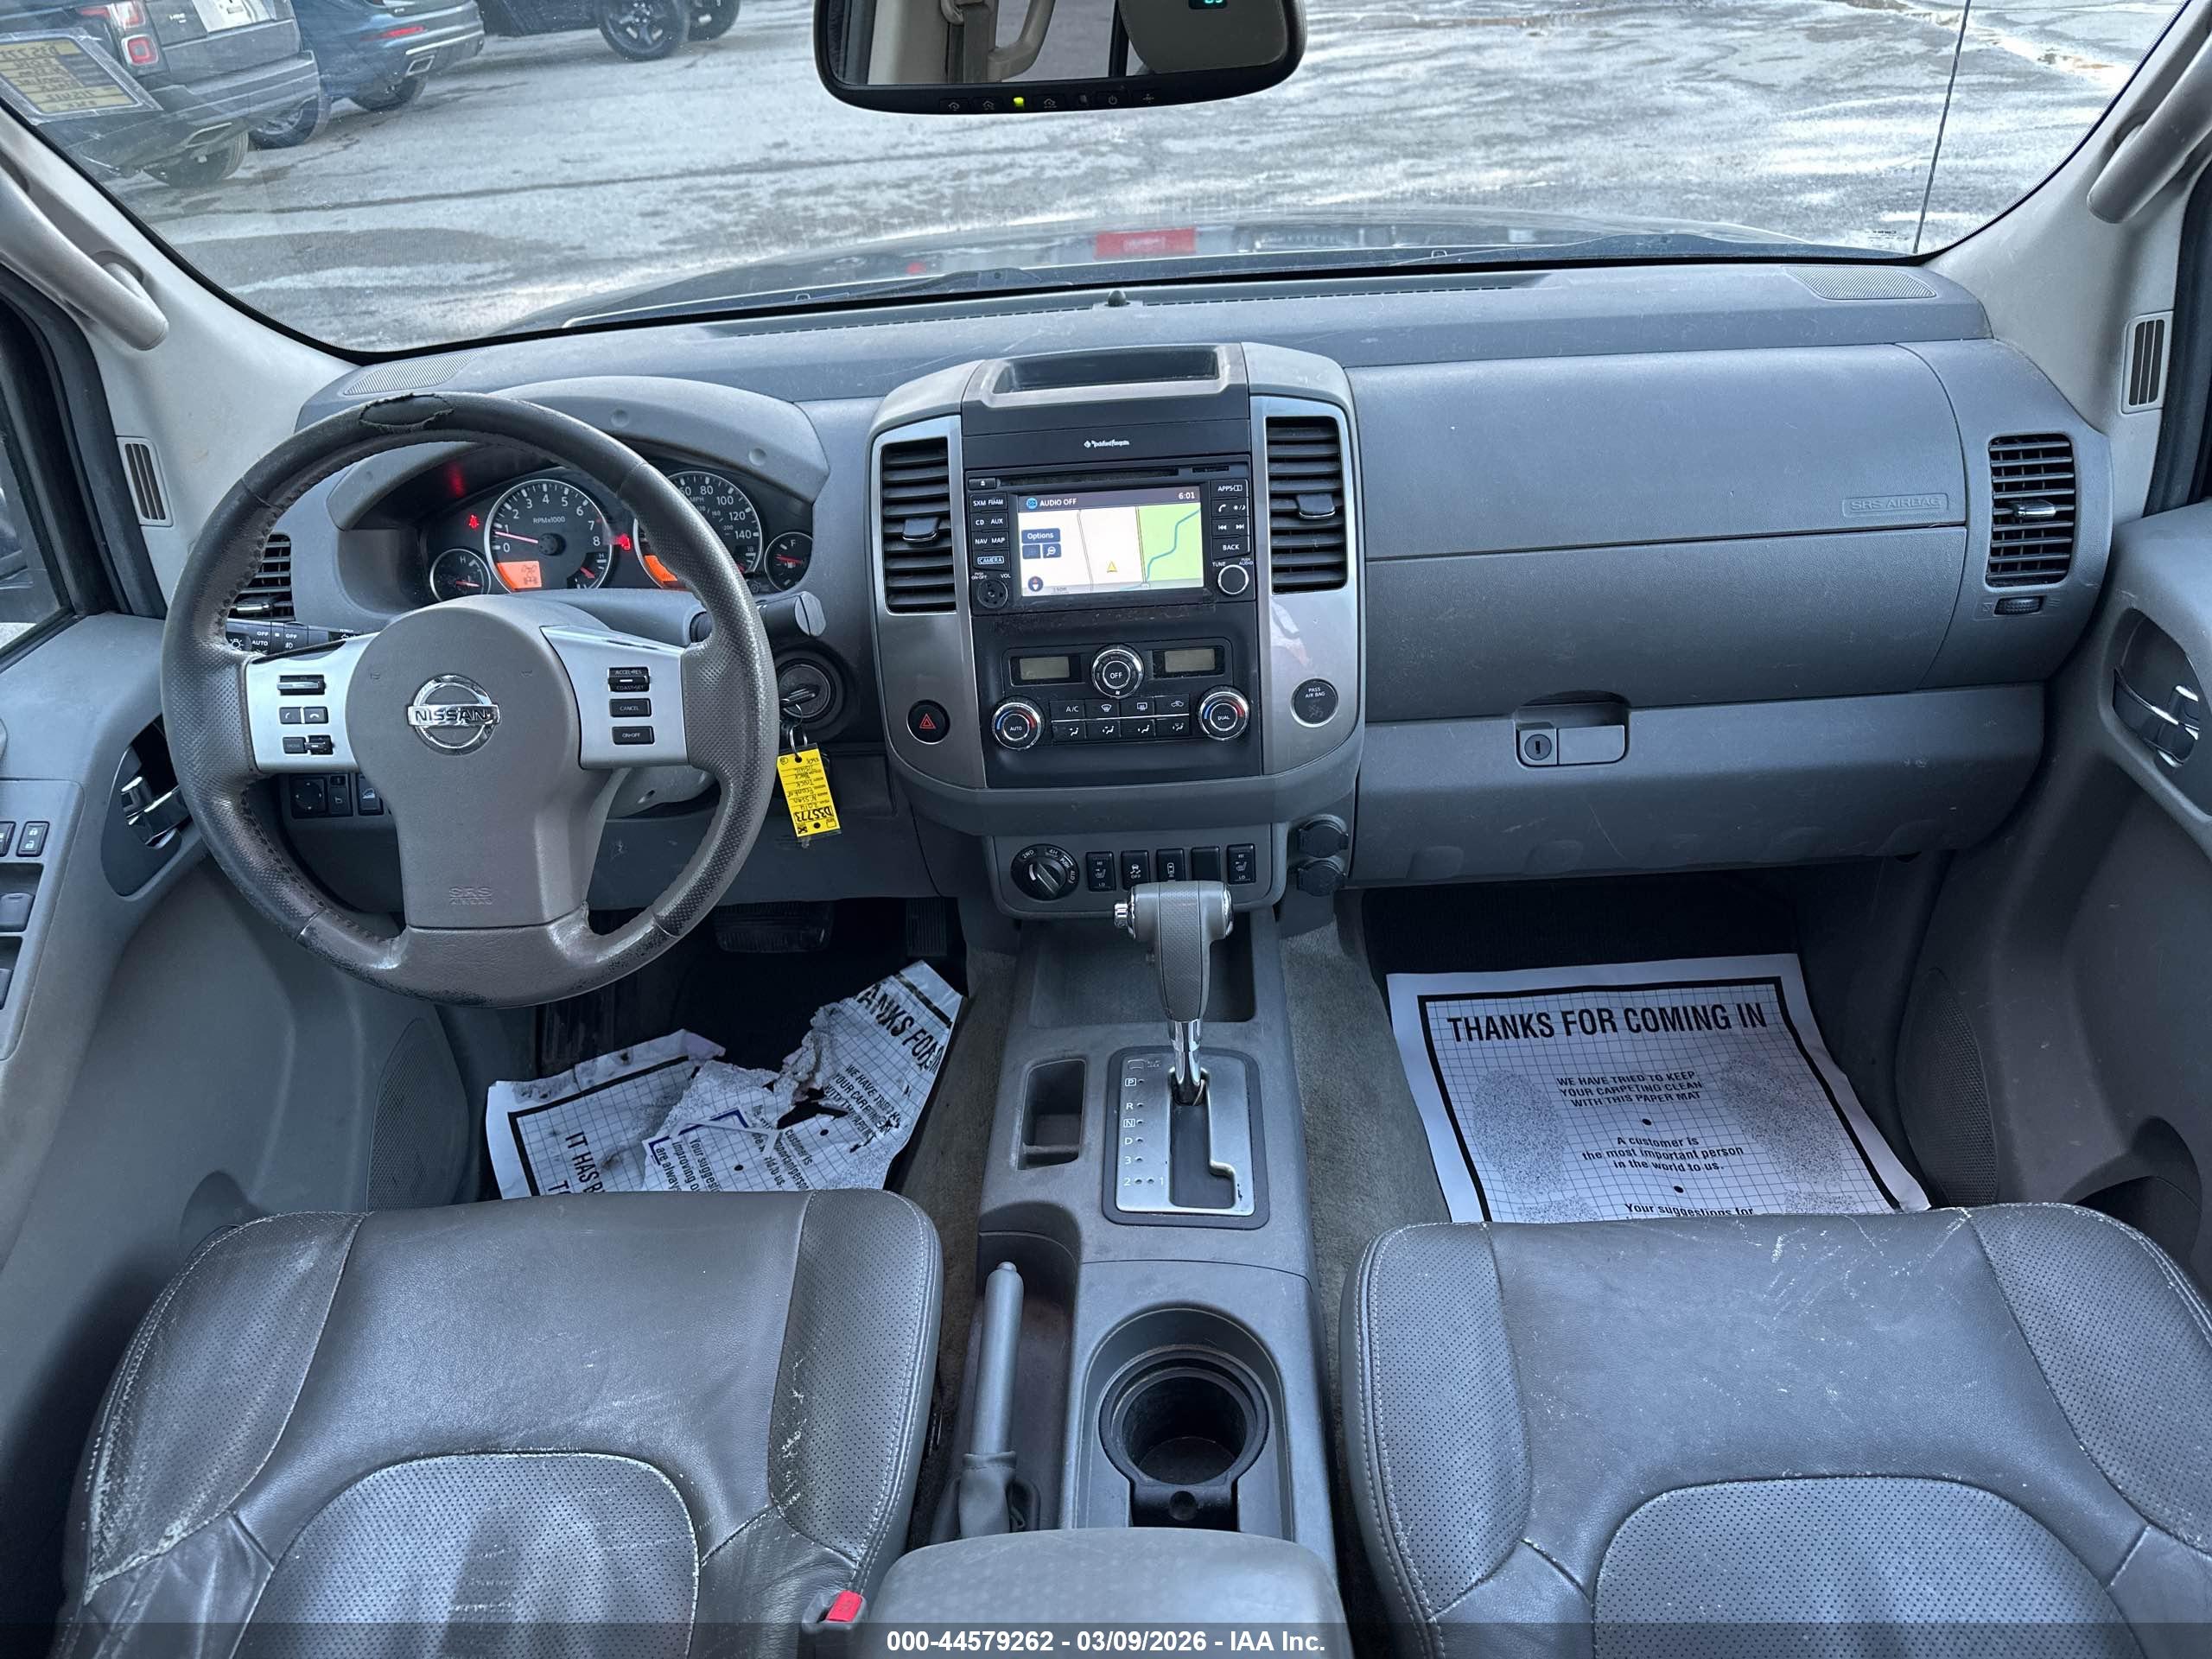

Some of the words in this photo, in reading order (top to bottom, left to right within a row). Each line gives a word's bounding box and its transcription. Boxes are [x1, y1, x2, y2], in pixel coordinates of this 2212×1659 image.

[700, 486, 714, 495] 80
[1179, 491, 1196, 500] 6:01
[526, 499, 533, 509] 3
[542, 493, 550, 504] 4
[562, 497, 569, 507] 5
[717, 495, 734, 505] 100
[1850, 500, 1883, 511] SRS
[1886, 497, 1942, 509] AIRBAG
[512, 510, 519, 519] 2
[576, 506, 584, 516] 6
[729, 511, 746, 521] 120
[588, 520, 594, 531] 7
[734, 530, 752, 540] 140
[593, 536, 601, 546] 8
[503, 543, 510, 552] 0
[415, 707, 486, 721] NISSAN
[1065, 704, 1079, 714] A/C
[794, 806, 832, 823] D35773
[1446, 1012, 1555, 1043] THANKS
[1560, 1007, 1618, 1037] FOR
[1623, 1003, 1733, 1035] COMING
[1735, 1002, 1768, 1029] IN
[1556, 1077, 1577, 1086] WE
[1578, 1076, 1609, 1086] HAVE
[1610, 1074, 1645, 1084] TRIED
[1665, 1071, 1695, 1081] KEEP
[1560, 1088, 1594, 1097] YOUR
[1596, 1084, 1662, 1096] CARPETING
[1664, 1081, 1703, 1092] CLEAN
[1571, 1098, 1603, 1107] WITH
[1604, 1095, 1633, 1104] THIS
[1635, 1093, 1675, 1103] PAPER
[1675, 1091, 1701, 1101] MAT
[565, 1131, 588, 1148] IT
[1629, 1136, 1683, 1148] customer
[1687, 1136, 1700, 1146] is
[690, 1138, 702, 1158] Your
[1582, 1151, 1602, 1161] the
[1606, 1148, 1637, 1158] most
[1701, 1146, 1744, 1160] person
[656, 1147, 666, 1161] are
[1125, 1156, 1132, 1165] 3
[572, 1152, 600, 1183] HAS
[1613, 1160, 1625, 1169] in
[1629, 1160, 1649, 1169] the
[1650, 1162, 1685, 1173] world
[1688, 1163, 1701, 1173] to
[1704, 1162, 1724, 1171] us.
[1624, 1203, 1655, 1213] Your
[1657, 1205, 1733, 1217] suggestions
